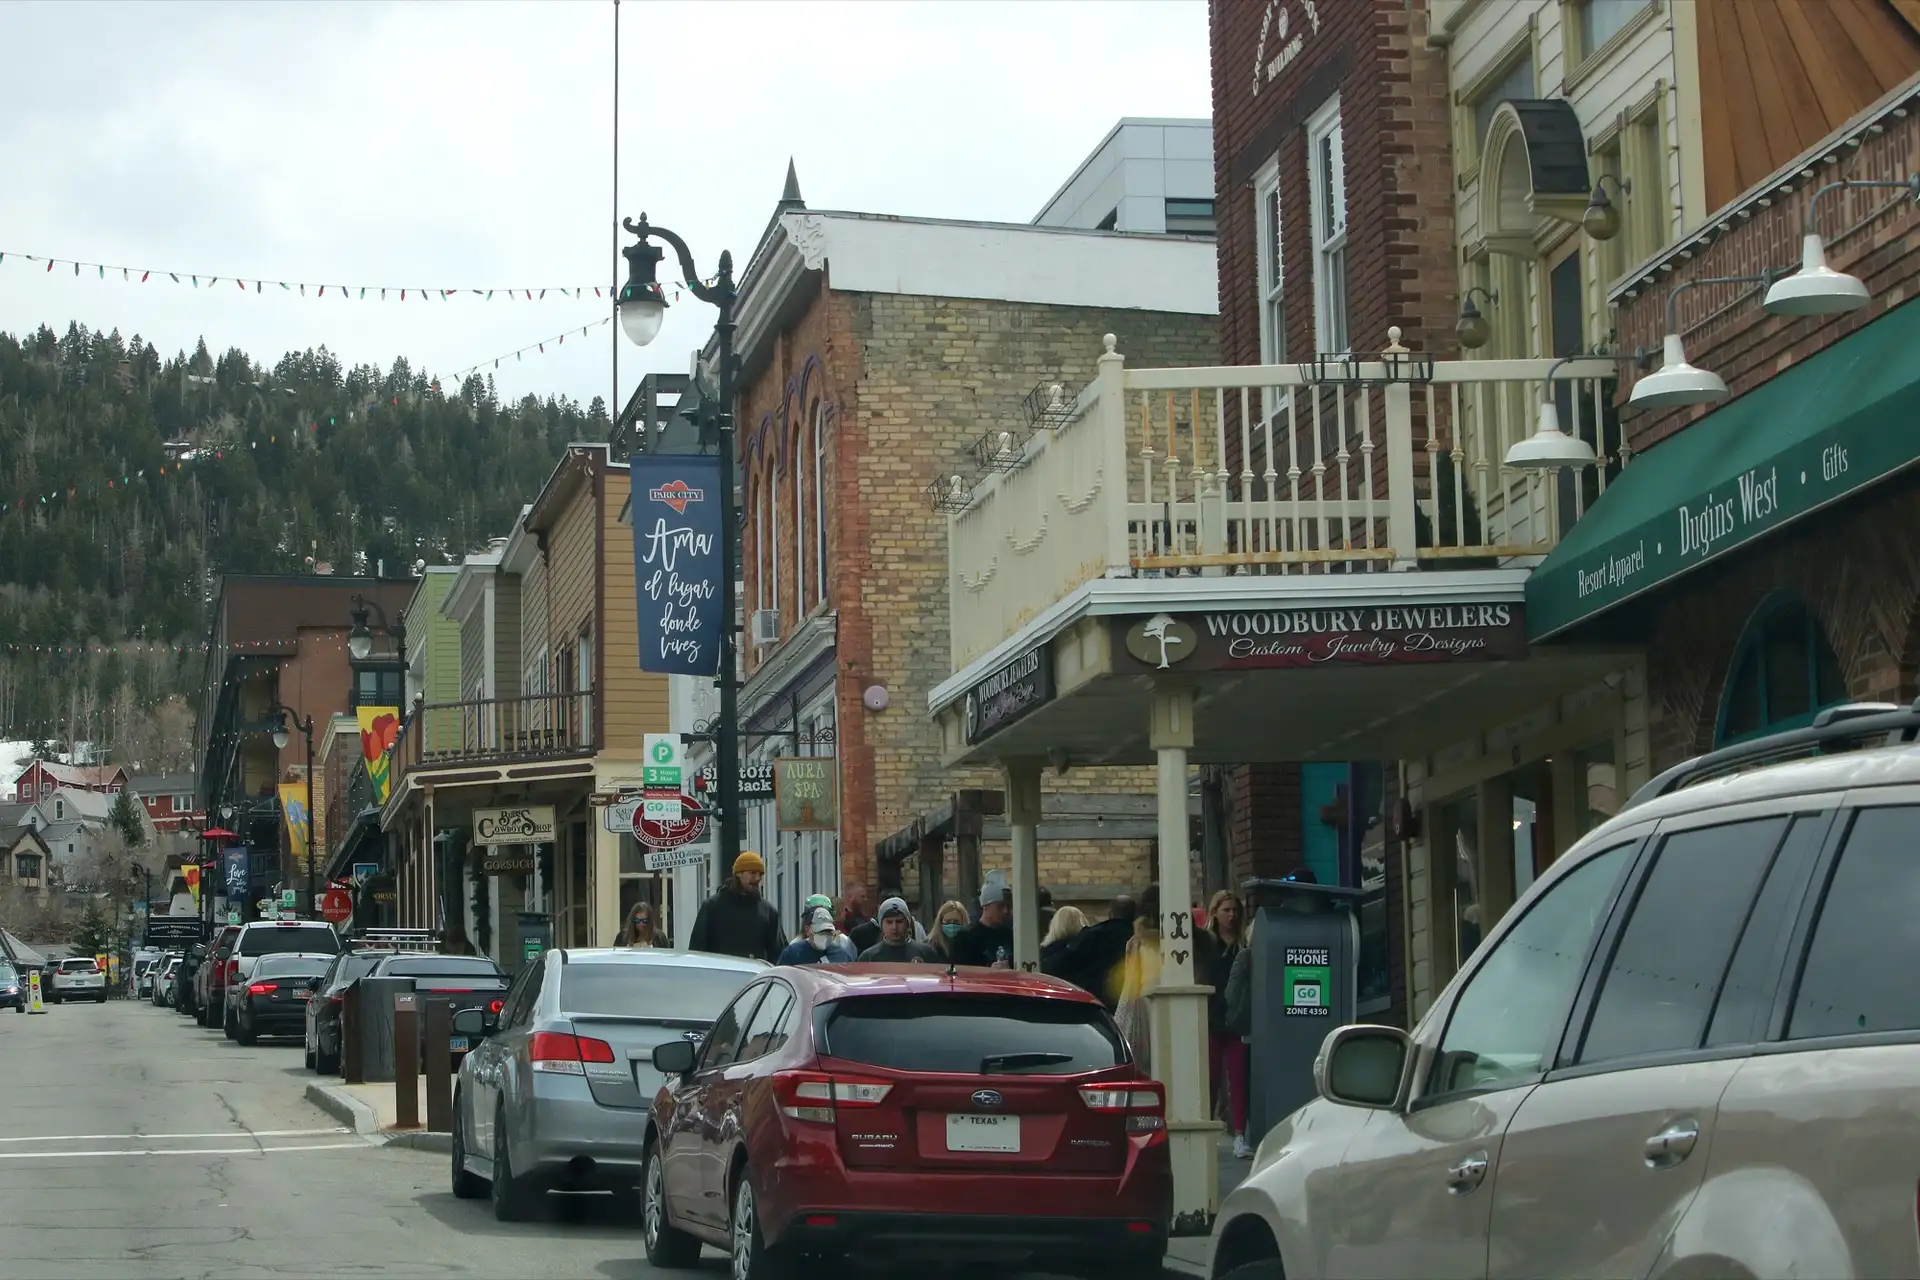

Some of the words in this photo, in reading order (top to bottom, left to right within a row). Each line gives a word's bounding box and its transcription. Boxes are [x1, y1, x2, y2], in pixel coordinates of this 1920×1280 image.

[653, 491, 676, 499] PARK
[677, 491, 700, 499] CITY
[1578, 566, 1607, 598] Resort
[1609, 540, 1644, 587] Apparel
[1679, 494, 1734, 556] Dugins
[1738, 466, 1778, 525] West
[1822, 443, 1848, 482] Gifts
[643, 518, 713, 572] Ama
[644, 570, 663, 600] el
[668, 572, 715, 607] lugar
[660, 602, 702, 635] donde
[1205, 609, 1365, 637] WOODBURY
[1371, 604, 1511, 632] JEWELERS
[661, 637, 702, 663] vives
[1229, 637, 1304, 659] Custom
[1307, 633, 1398, 662] Jewelry
[1403, 632, 1488, 655] Designs
[1009, 649, 1039, 686] JEWELERS
[648, 768, 658, 782] 3
[786, 761, 826, 779] AURA
[794, 781, 822, 799] SPA
[478, 818, 521, 838] COWBOY
[521, 809, 552, 837] SHOP
[635, 824, 664, 847] GOURMET
[673, 835, 689, 845] GIFT
[690, 818, 704, 838] SHOP
[484, 859, 534, 870] GORSUCH
[651, 851, 685, 862] GELATO
[652, 859, 687, 869] ESPRESSO
[688, 856, 703, 864] BAR
[226, 863, 247, 886] Love
[1287, 954, 1328, 964] PHONE
[970, 1116, 998, 1125] TEXAS
